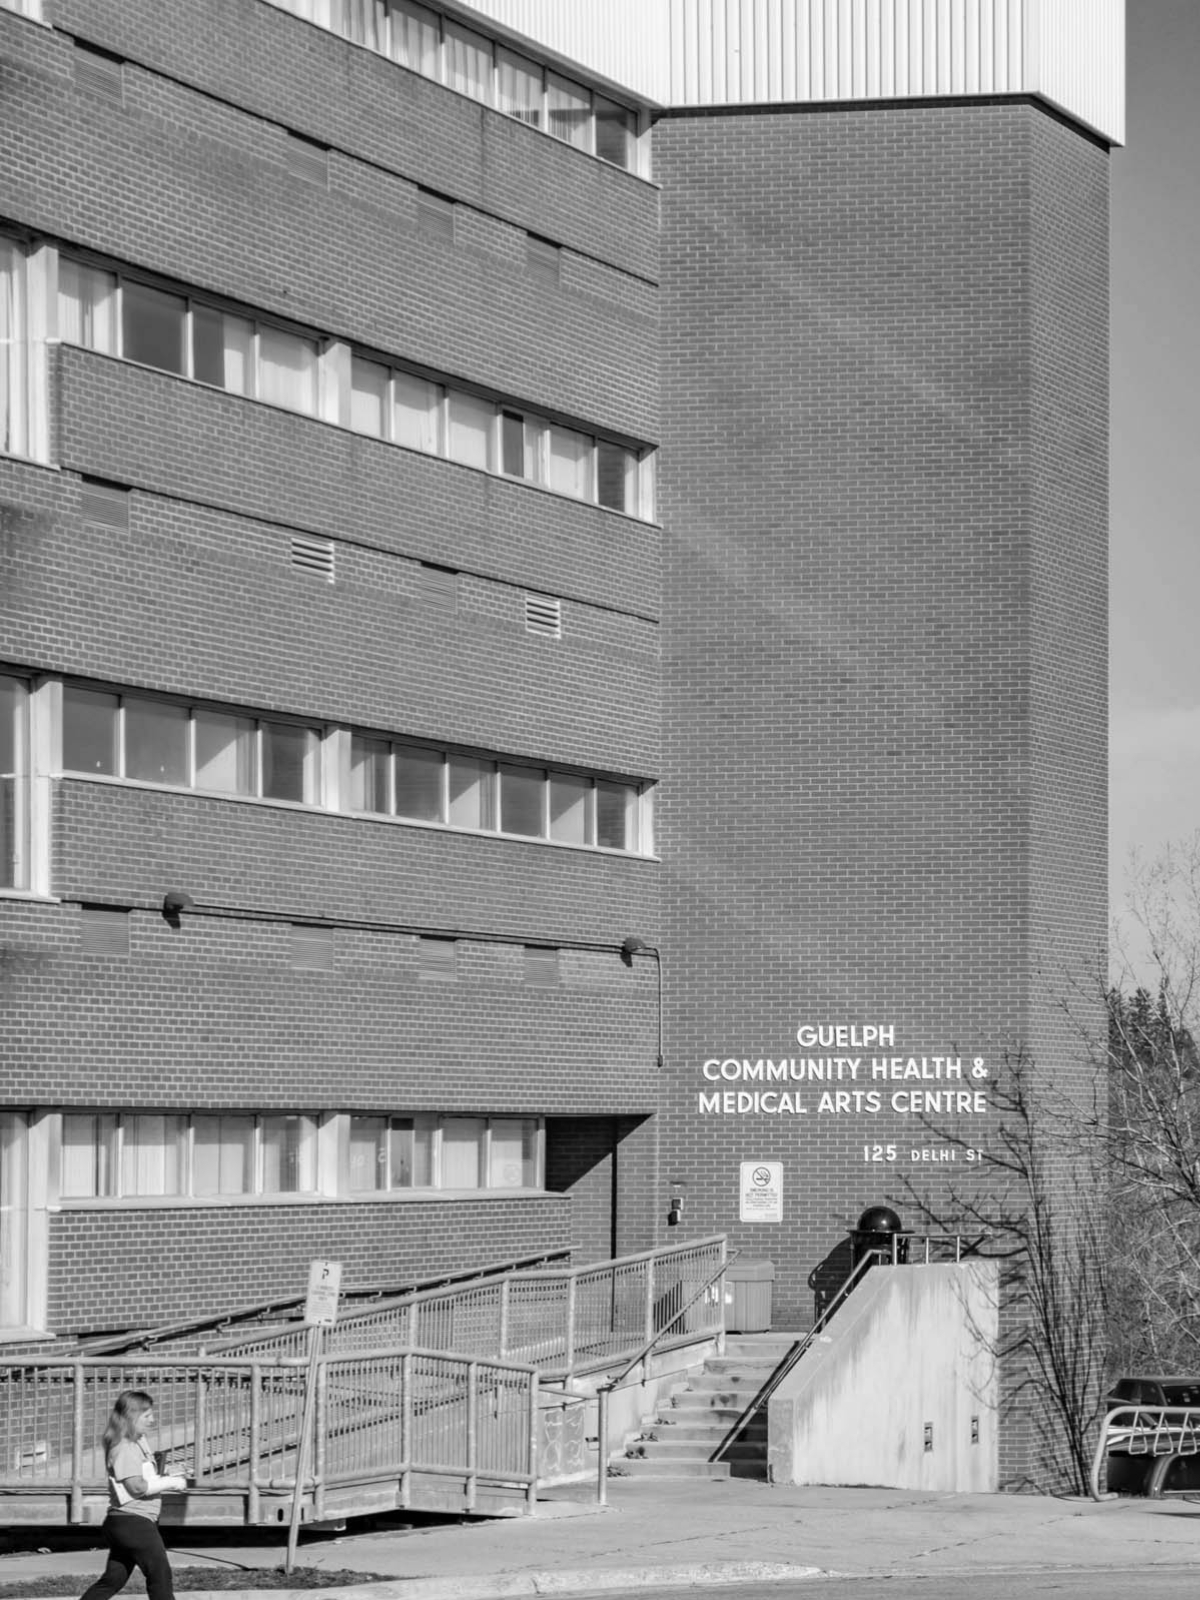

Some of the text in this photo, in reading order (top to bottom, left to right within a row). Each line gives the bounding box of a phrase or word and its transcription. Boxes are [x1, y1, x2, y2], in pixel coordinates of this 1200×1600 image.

[796, 1025, 895, 1047] GUELPH
[703, 1057, 988, 1081] COMMUNITY HEALTH &
[699, 1091, 986, 1114] MEDICAL ARTS CENTRE
[864, 1145, 984, 1161] 125 DELHI ST
